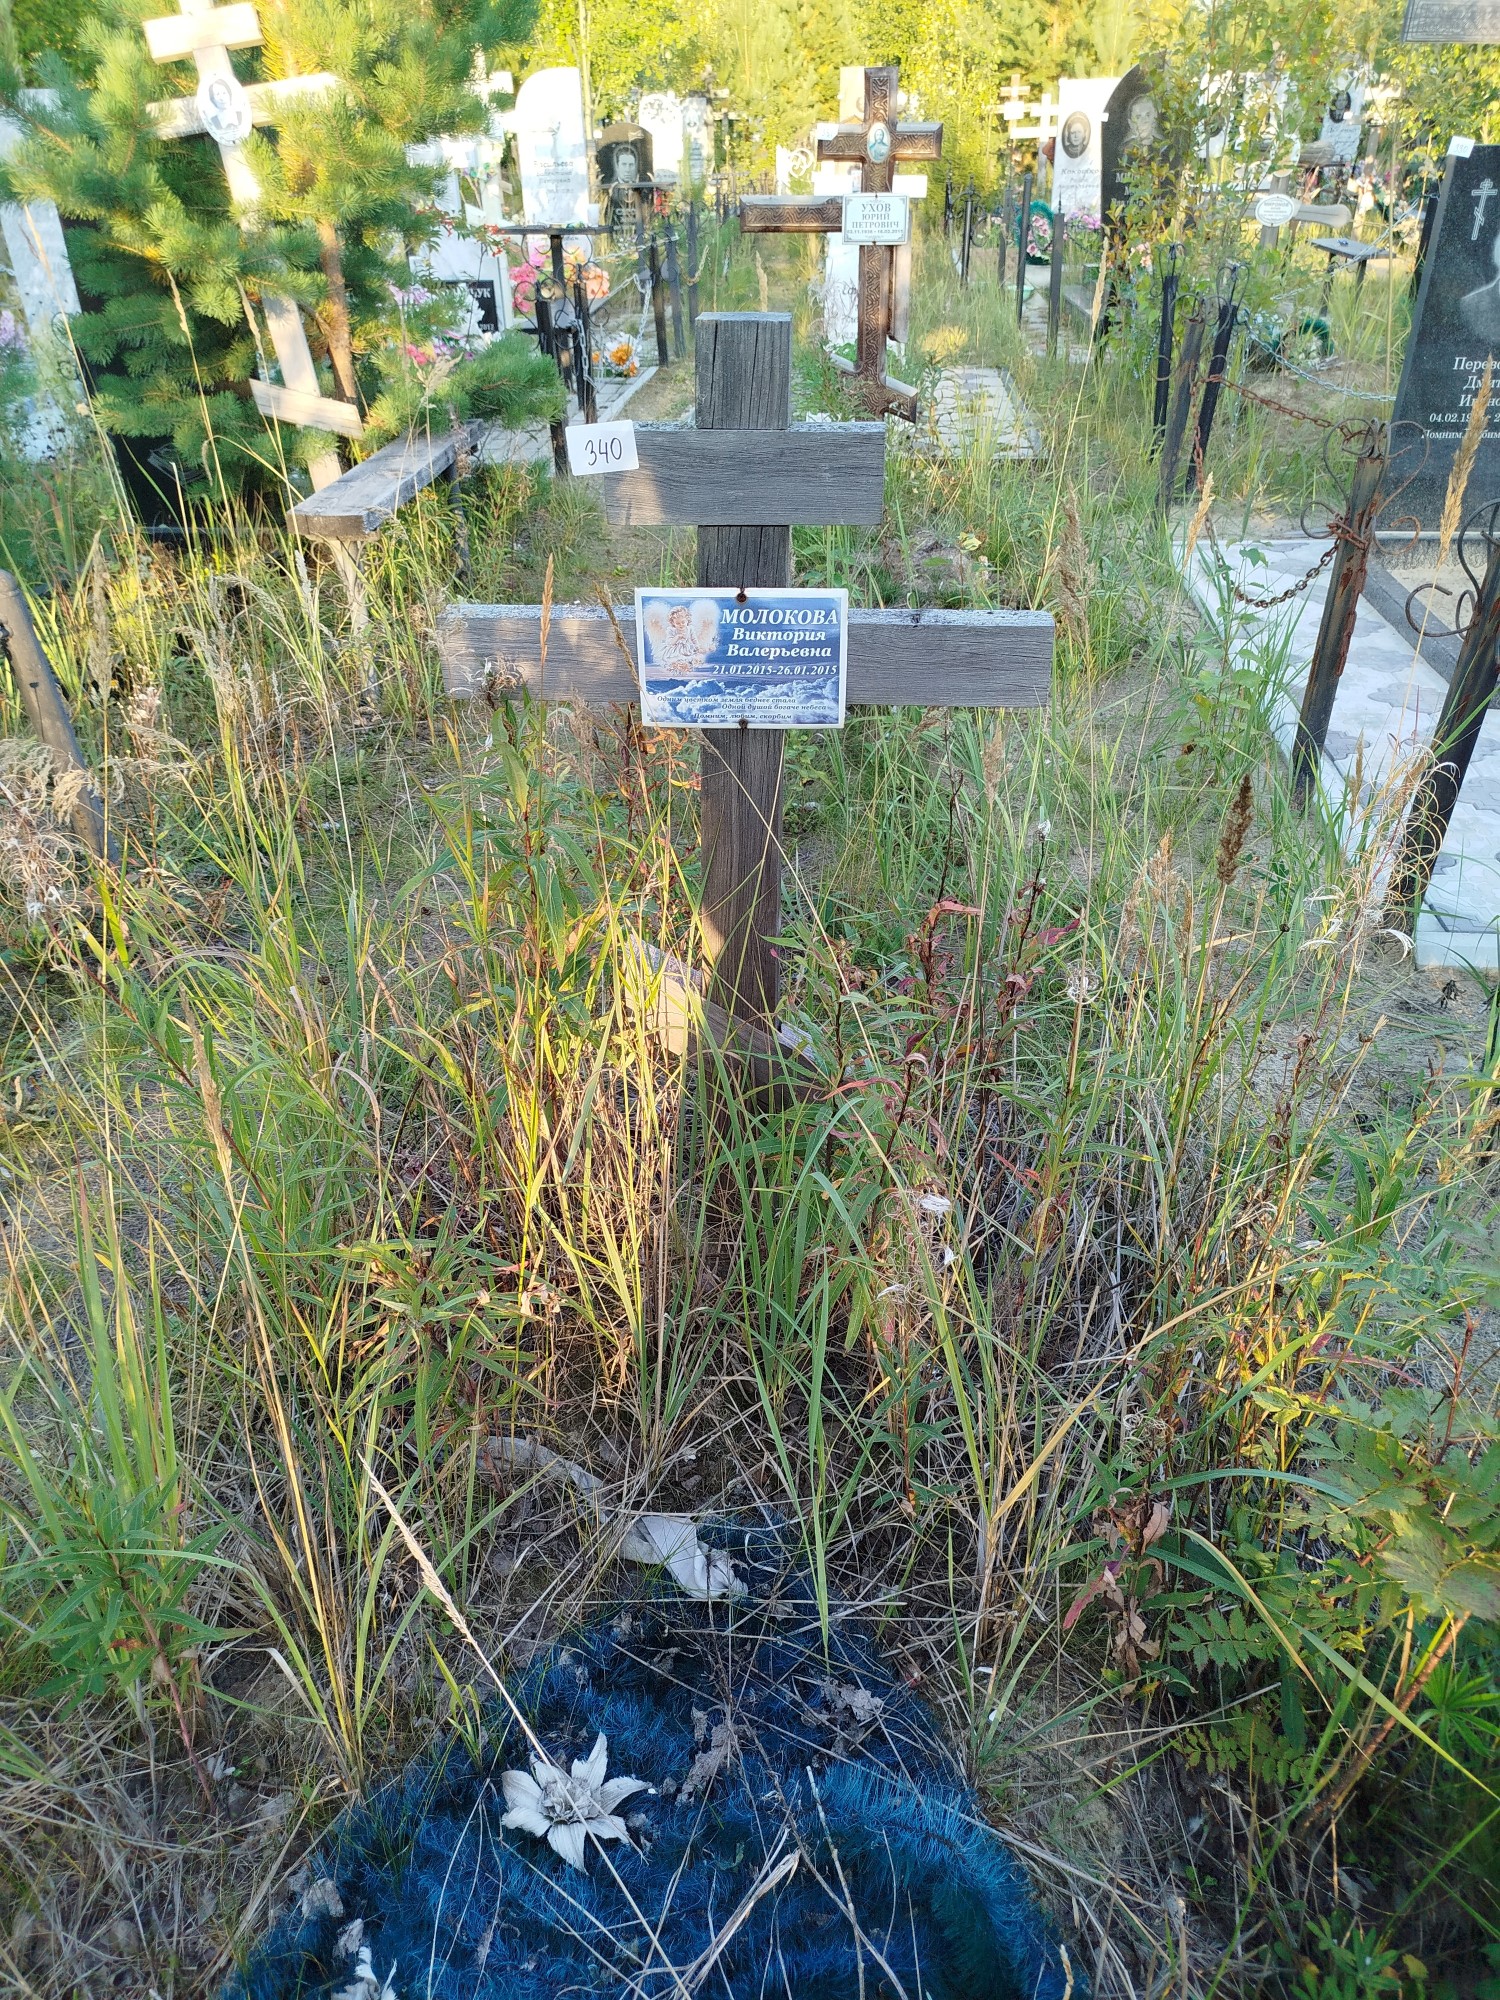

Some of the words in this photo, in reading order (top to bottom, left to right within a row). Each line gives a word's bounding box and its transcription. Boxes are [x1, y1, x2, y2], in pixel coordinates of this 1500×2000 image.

[861, 203, 891, 213] УХОВ
[862, 213, 890, 221] ЮРИЙ
[852, 221, 899, 229] ПЕТРОВИЧ
[1429, 413, 1485, 423] 04.02.19
[585, 437, 622, 466] 340
[721, 608, 838, 625] МОЛОКОВА
[732, 627, 826, 644] Виктория
[726, 643, 832, 660] Валерьевна
[712, 665, 837, 675] 21.01.2015-26.01.2015
[657, 695, 682, 703] Одним
